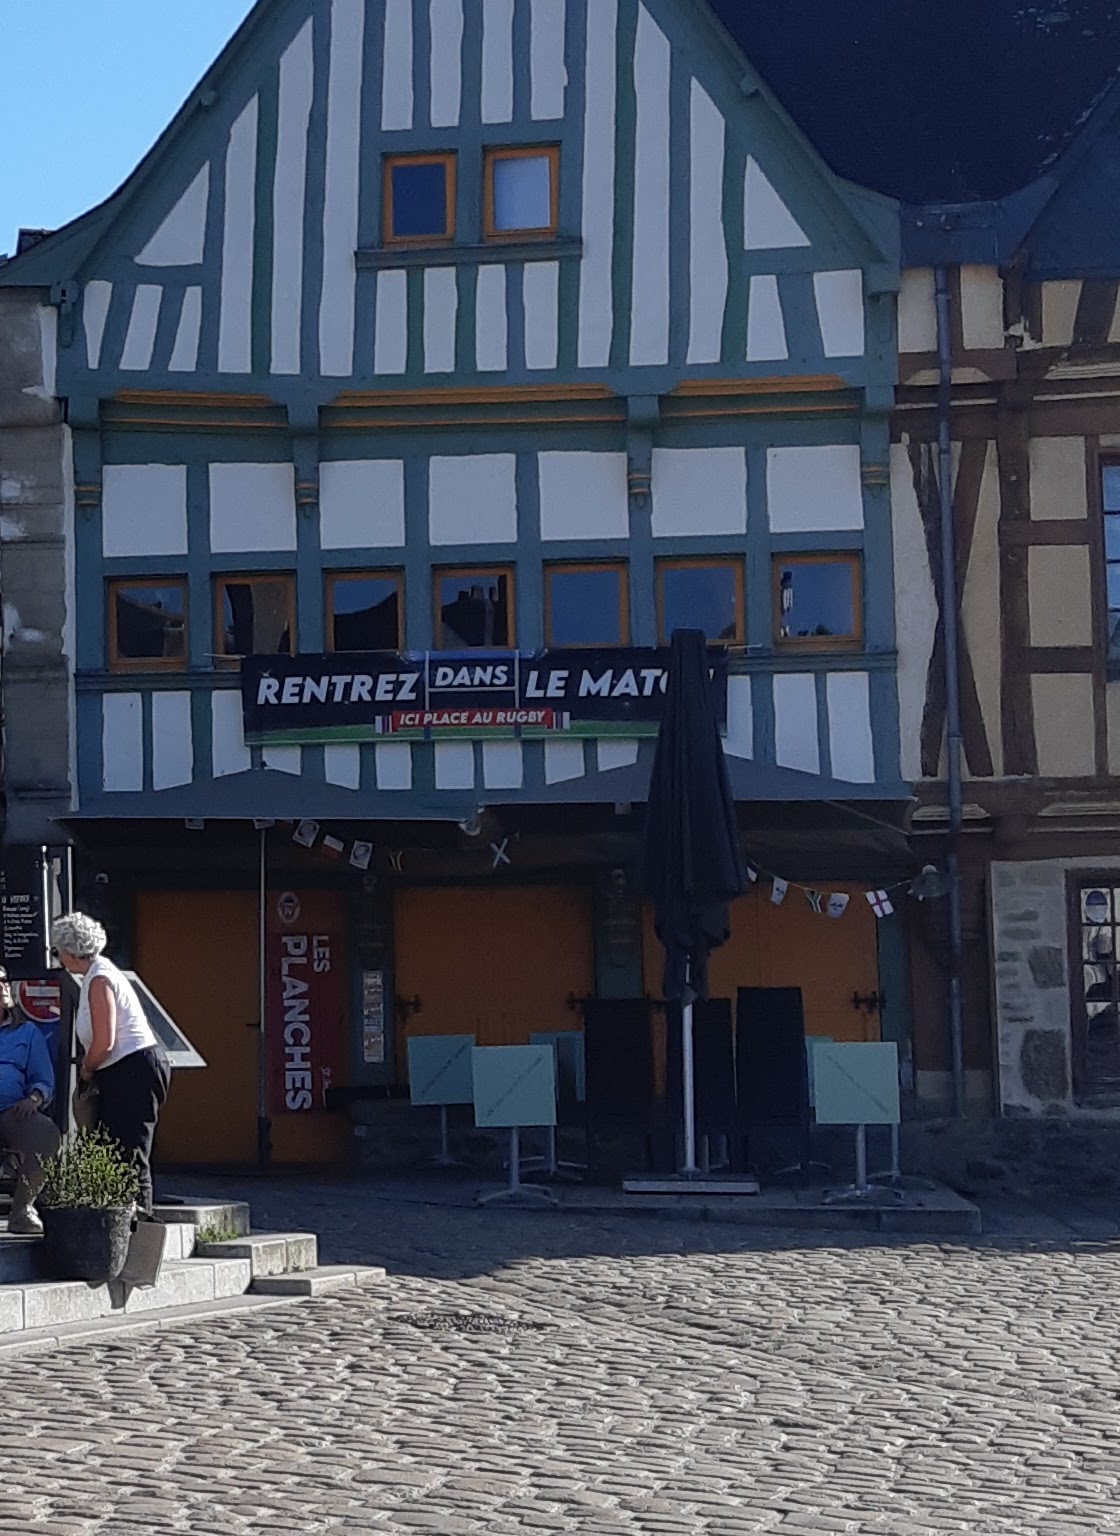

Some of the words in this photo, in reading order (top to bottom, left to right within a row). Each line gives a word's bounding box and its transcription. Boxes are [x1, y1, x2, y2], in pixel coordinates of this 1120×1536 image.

[257, 672, 419, 705] RENTREZ
[434, 665, 509, 687] DANS
[525, 669, 569, 698] LE
[399, 714, 419, 725] ICI
[423, 712, 468, 725] PLACE
[471, 712, 493, 724] AU
[496, 710, 546, 723] RUGBY
[313, 935, 330, 973] LES
[281, 935, 312, 1110] PLANCHES
